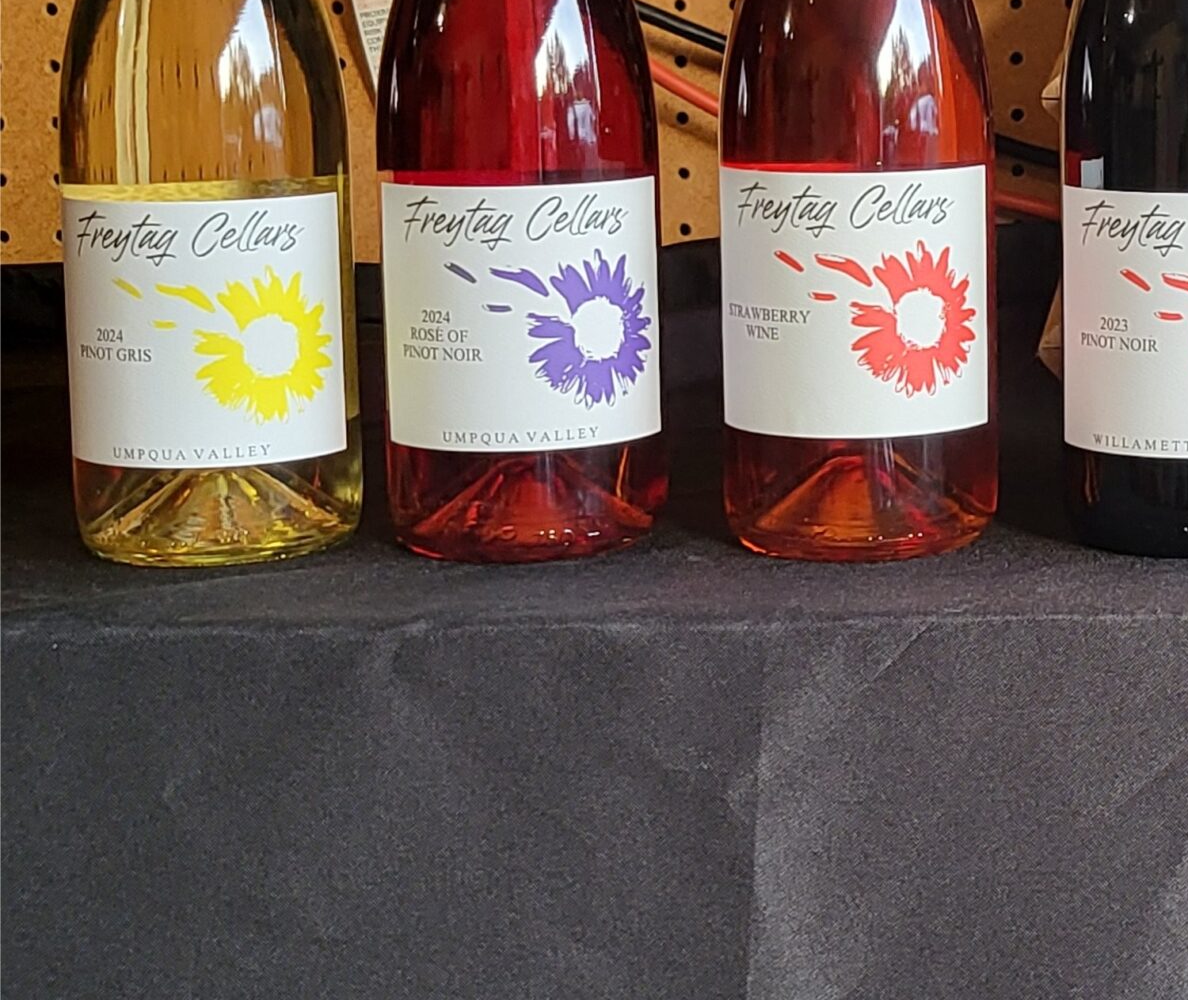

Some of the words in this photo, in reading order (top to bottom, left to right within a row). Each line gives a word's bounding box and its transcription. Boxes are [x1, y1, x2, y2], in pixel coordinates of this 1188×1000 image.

[737, 181, 838, 238] Freytag
[850, 183, 955, 229] Cellars
[403, 195, 515, 251] Freytag
[526, 193, 629, 242] Cellars
[1081, 199, 1186, 258] Freytag
[77, 210, 179, 267] Freytag
[191, 210, 305, 258] Cellars
[421, 309, 451, 324] 2024
[729, 302, 811, 324] STRAWBERRY
[746, 324, 779, 341] WINE
[1100, 316, 1128, 332] 2023
[96, 328, 124, 343] 2024
[410, 325, 444, 344] ROSÉ
[447, 329, 468, 343] OF
[1081, 331, 1116, 350] PINOT
[1119, 335, 1159, 353] NOIR
[80, 344, 113, 361] PINOT
[116, 348, 152, 363] GRIS
[403, 344, 438, 361] PINOT
[442, 347, 483, 362] NOIR
[442, 430, 520, 446] UMPQUA
[526, 425, 599, 442] VALLEY
[113, 446, 187, 463] UMPQUA
[193, 443, 271, 460] VALLEY
